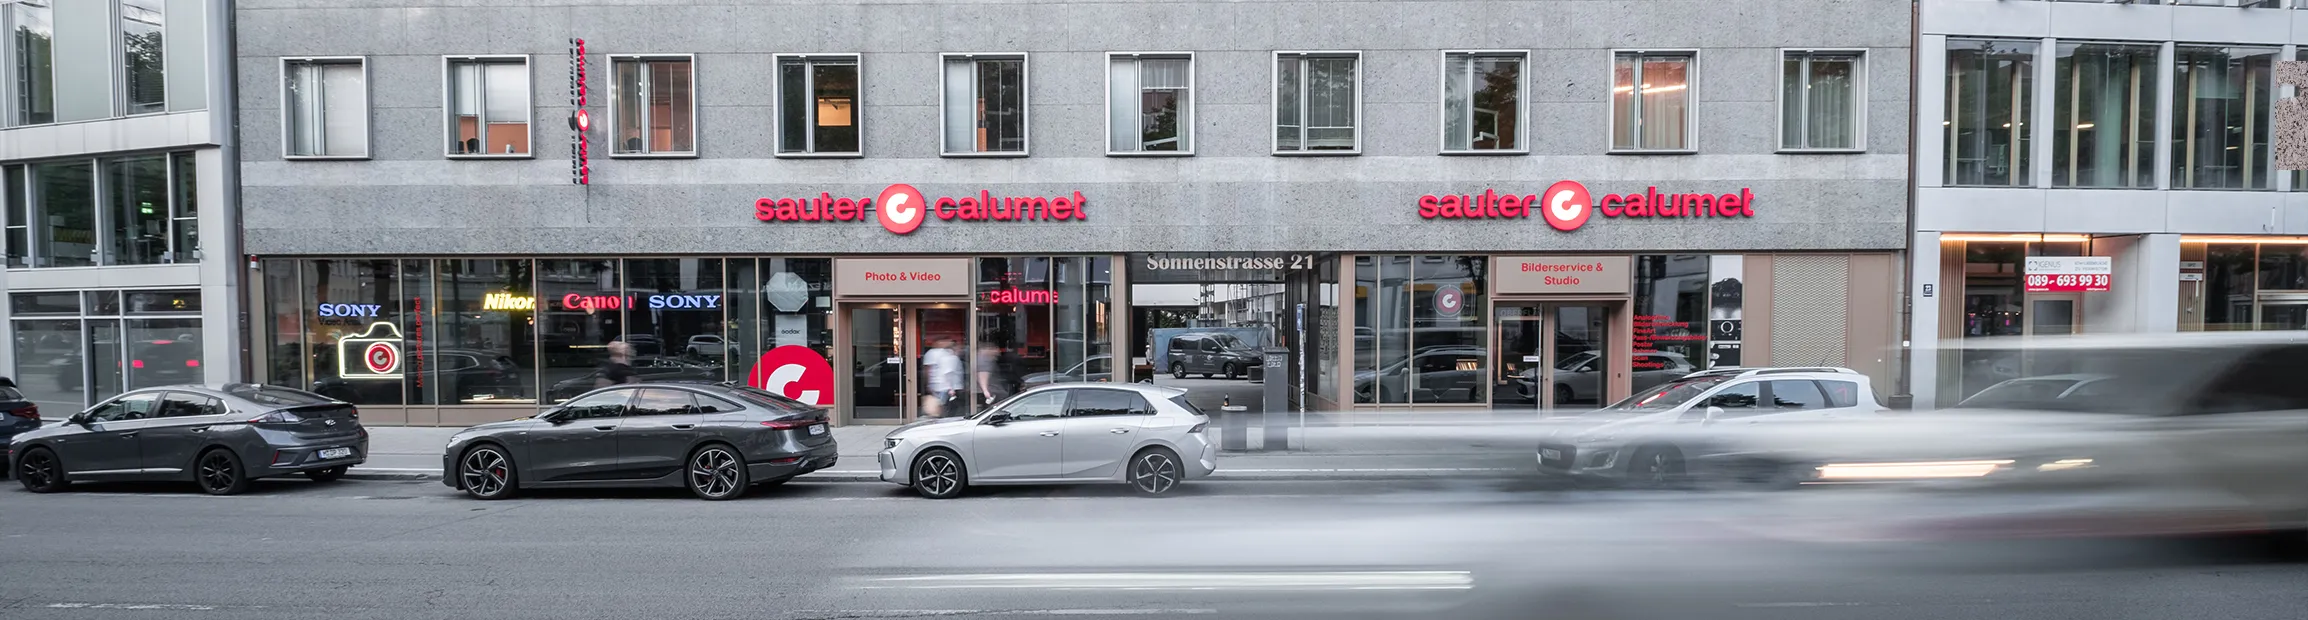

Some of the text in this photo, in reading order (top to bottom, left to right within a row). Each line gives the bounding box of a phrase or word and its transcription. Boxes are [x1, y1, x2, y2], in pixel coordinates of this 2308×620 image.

[754, 191, 871, 222] sauter
[933, 189, 1087, 221] calumet
[1417, 188, 1537, 219] sauter
[1599, 185, 1755, 217] calumet
[1146, 254, 1313, 270] Sonnenstrasse 21
[1521, 262, 1604, 273] Bilderservice &
[864, 271, 941, 282] Photo & Video
[1544, 274, 1581, 286] Studio
[2028, 275, 2048, 286] 089
[2056, 275, 2077, 286] 693
[2079, 275, 2092, 286] 99
[2094, 275, 2108, 286] 30
[649, 295, 720, 309] SONY
[319, 303, 381, 317] SONY
[413, 296, 423, 326] perfect
[1632, 361, 1664, 369] Shootings
